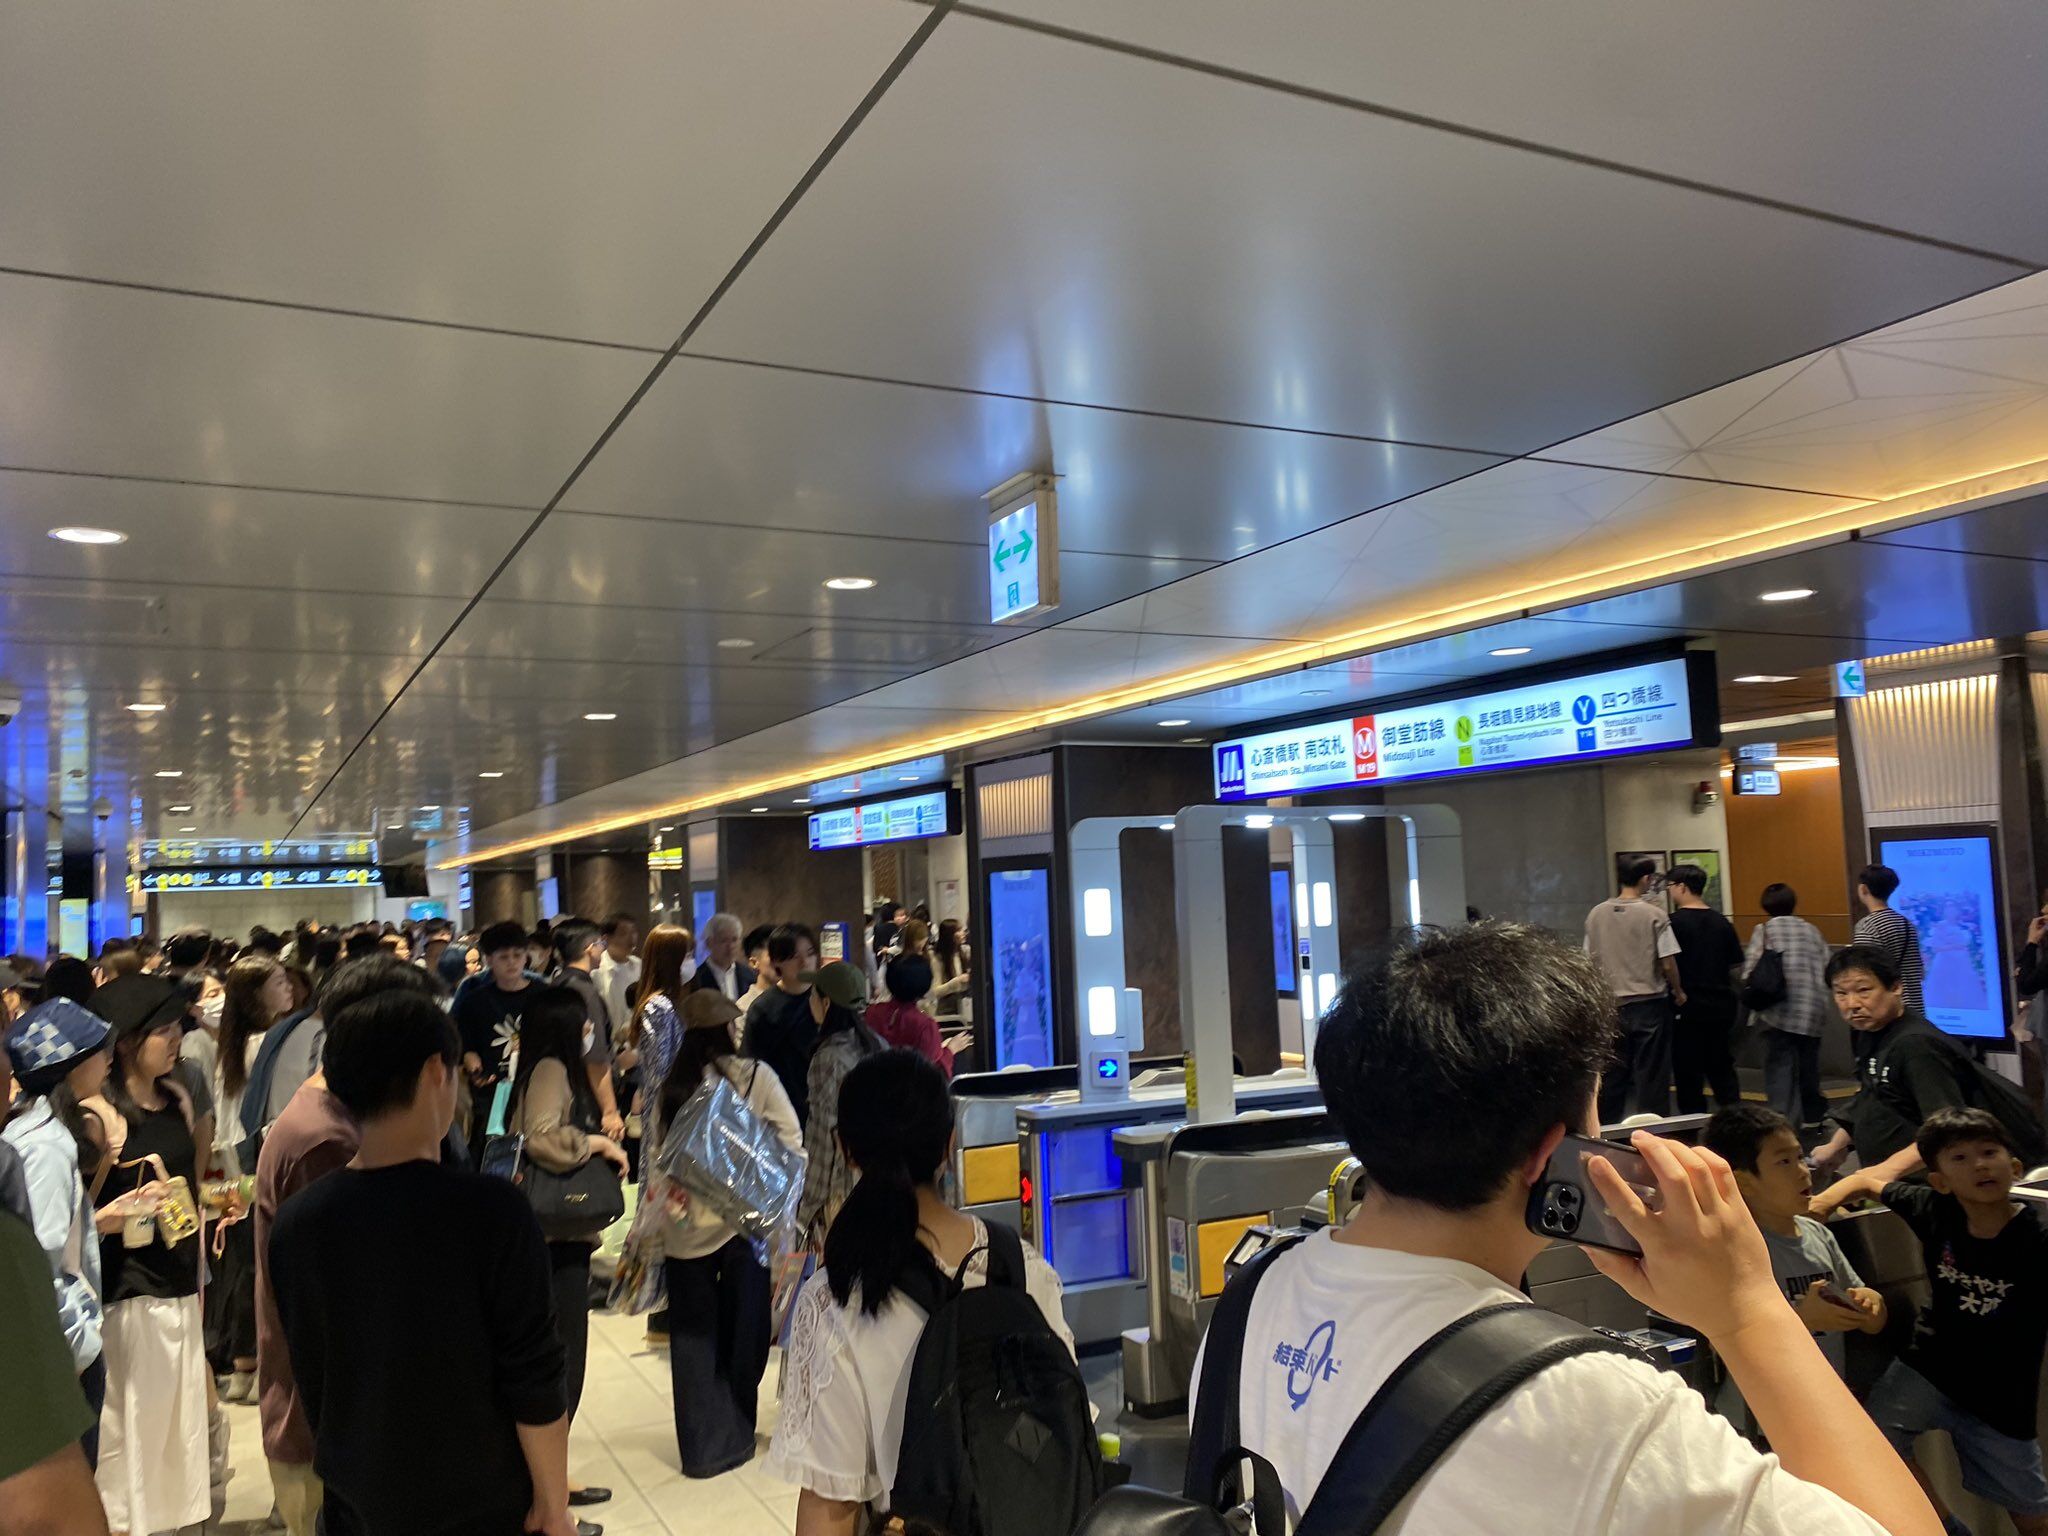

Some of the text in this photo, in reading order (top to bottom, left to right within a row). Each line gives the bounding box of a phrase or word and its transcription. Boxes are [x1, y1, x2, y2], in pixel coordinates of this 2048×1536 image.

[1602, 684, 1664, 709] 四つ橋線
[1577, 698, 1591, 722] Y
[1382, 718, 1446, 747] 御堂筋線
[1457, 719, 1471, 740] N
[1251, 735, 1346, 767] 心斎橋駅 南改札
[1417, 747, 1436, 758] Line
